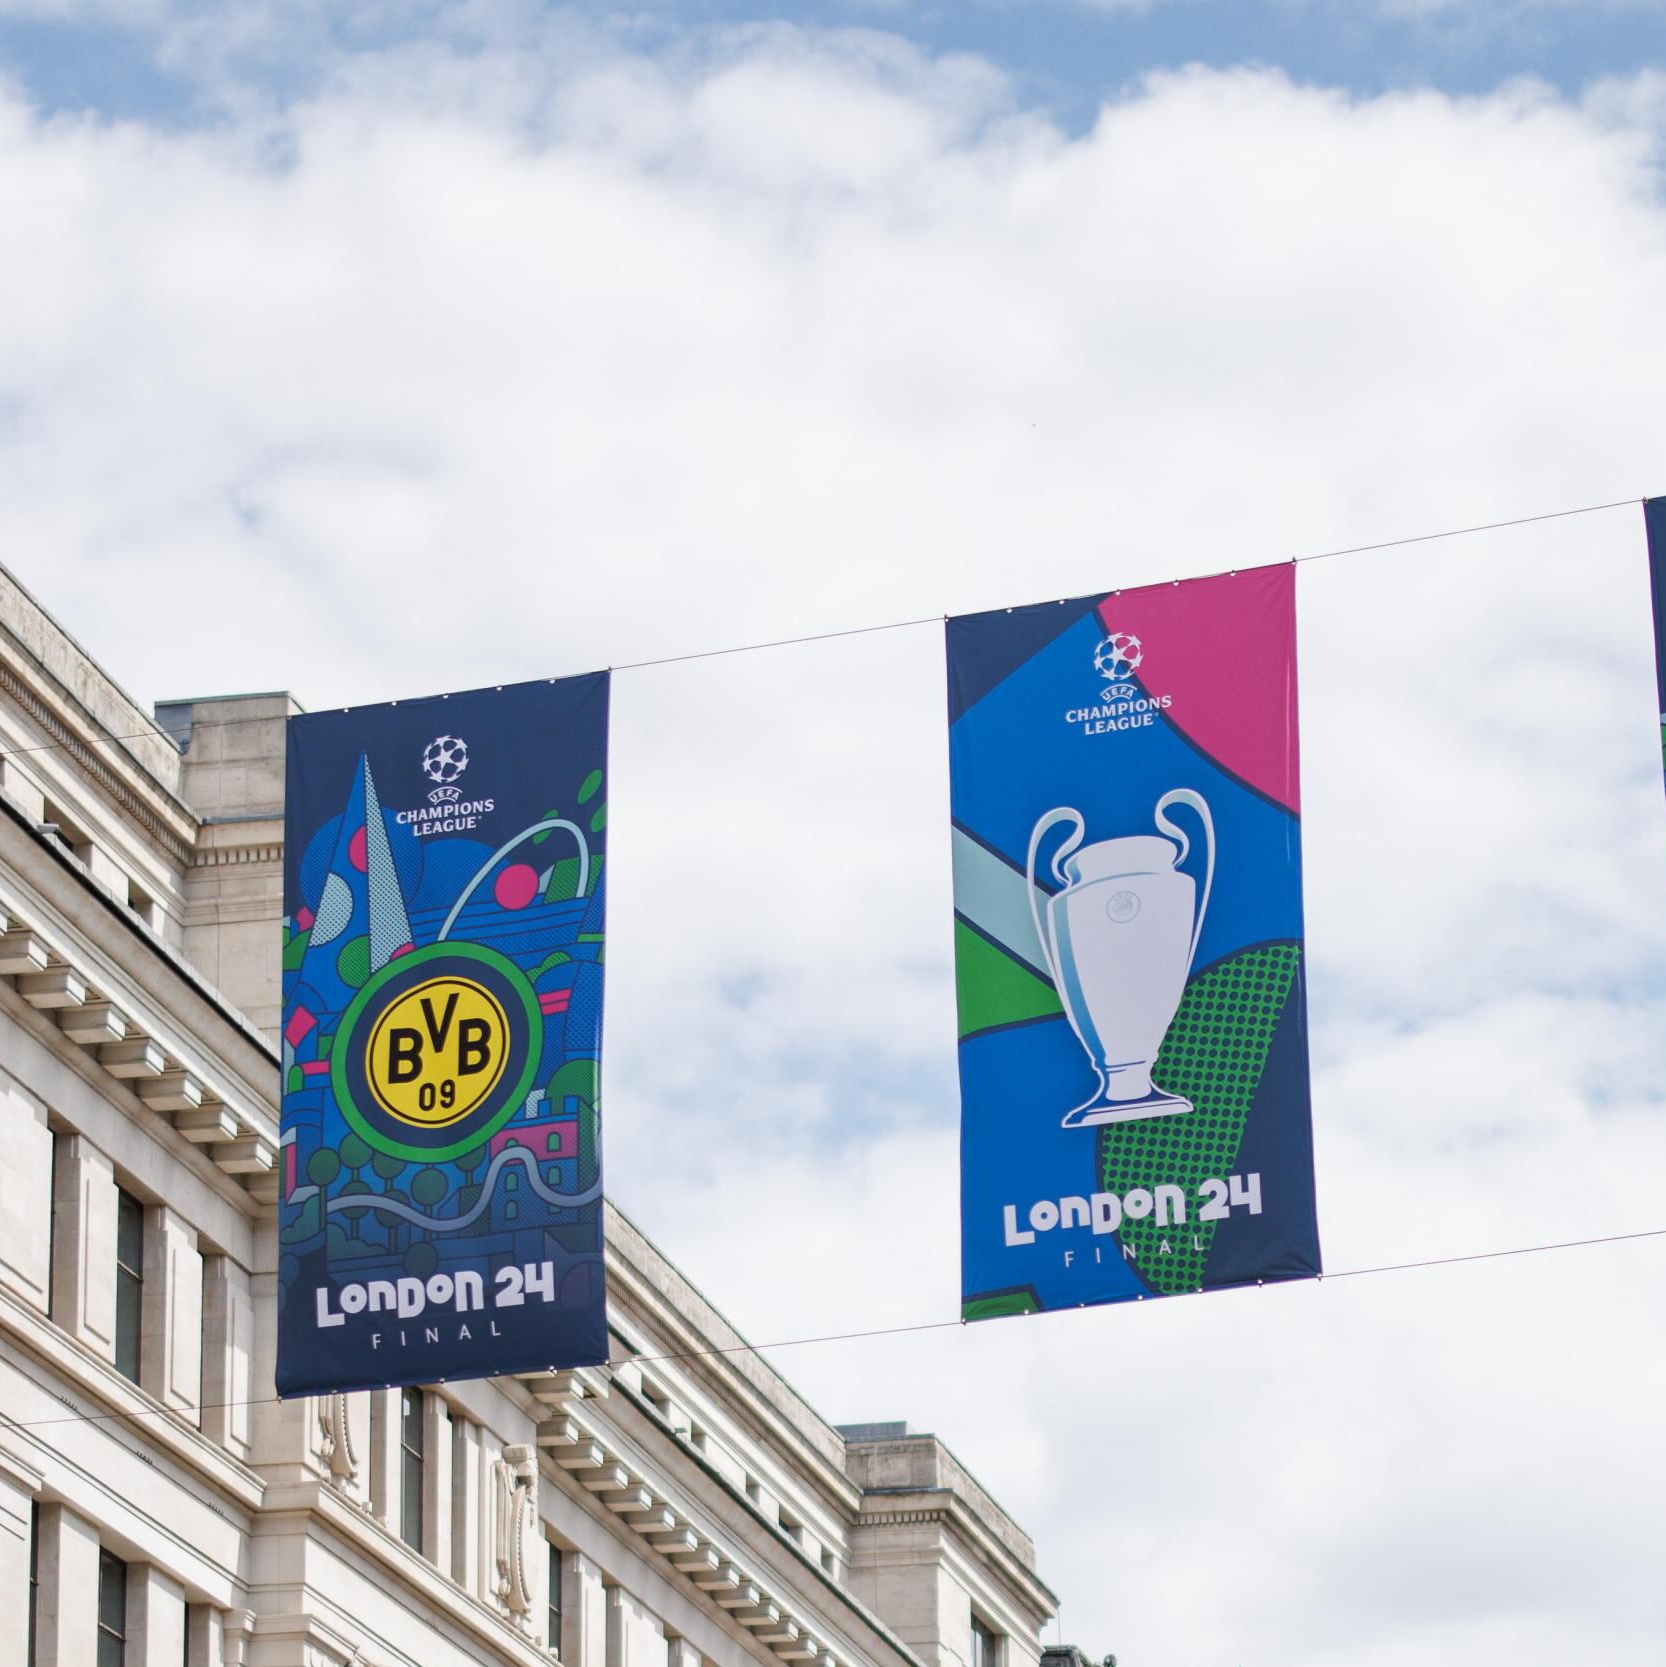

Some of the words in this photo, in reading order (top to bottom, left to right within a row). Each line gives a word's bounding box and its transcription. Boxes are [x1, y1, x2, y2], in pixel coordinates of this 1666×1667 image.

[1101, 684, 1137, 701] UEFA
[1065, 695, 1172, 724] CHAMPIONS
[1084, 712, 1154, 735] LEAGUE
[428, 786, 462, 803] UEFA
[396, 798, 494, 826] CHAMPIONS
[413, 815, 477, 837] LEAGUE
[387, 992, 492, 1085] BVB
[418, 1078, 456, 1113] 09
[1198, 1173, 1262, 1218] 24
[1065, 1236, 1204, 1268] FINAL
[495, 1261, 555, 1308] 24
[371, 1323, 502, 1351] FINAL
